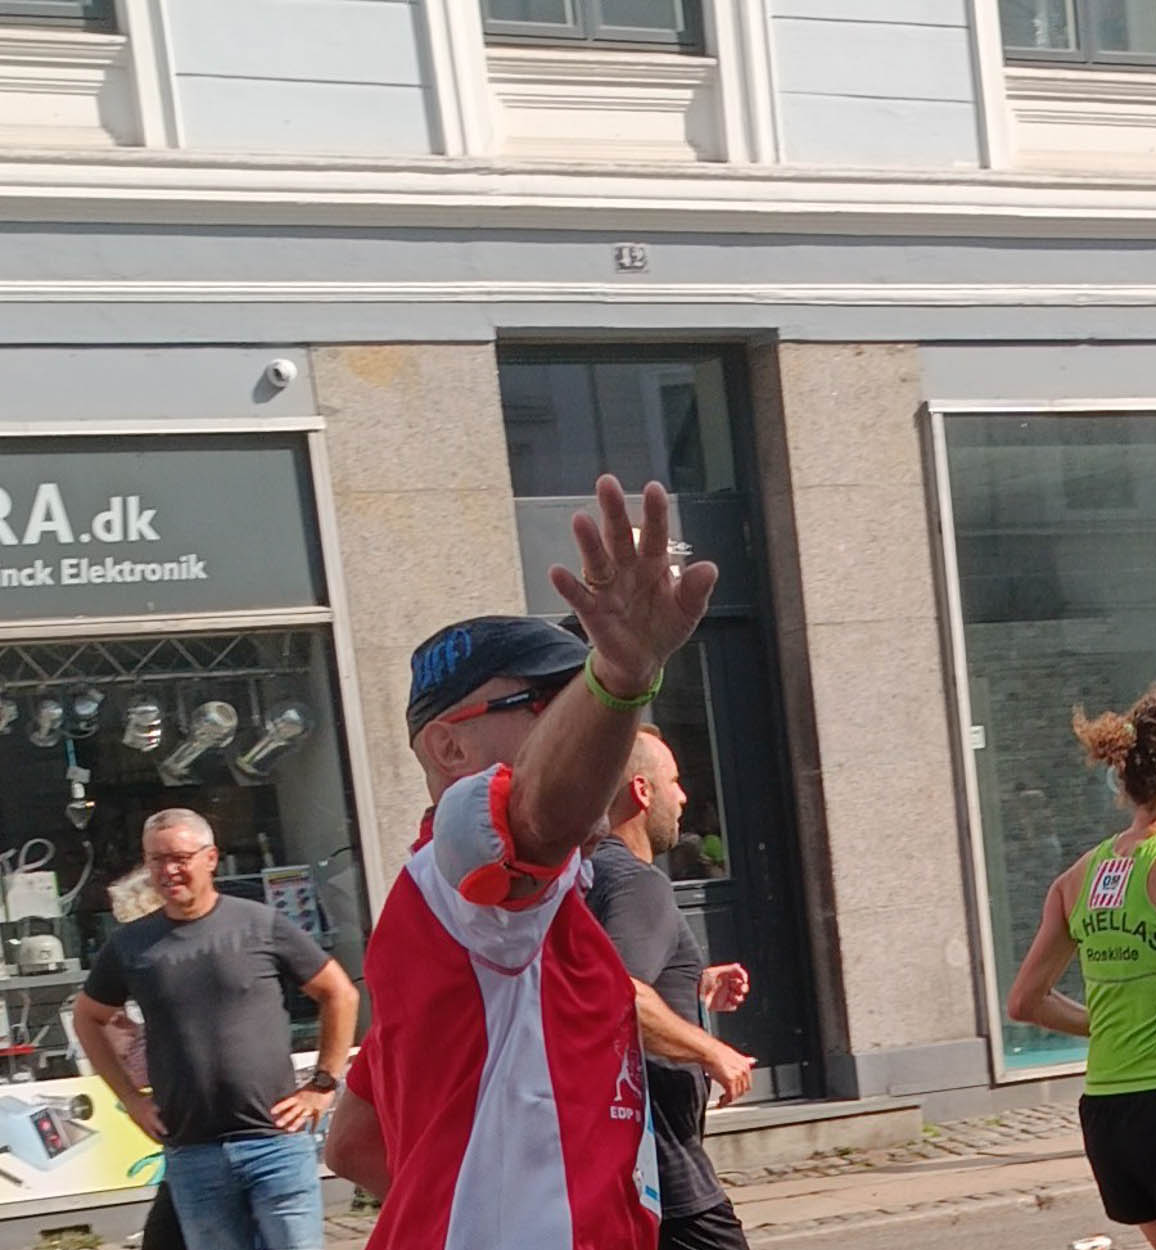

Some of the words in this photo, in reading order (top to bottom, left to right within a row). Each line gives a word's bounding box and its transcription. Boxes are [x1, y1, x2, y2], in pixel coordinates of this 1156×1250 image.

[60, 553, 209, 585] Elektronik
[1086, 946, 1140, 961] Roskilde
[609, 1105, 634, 1119] EDP
